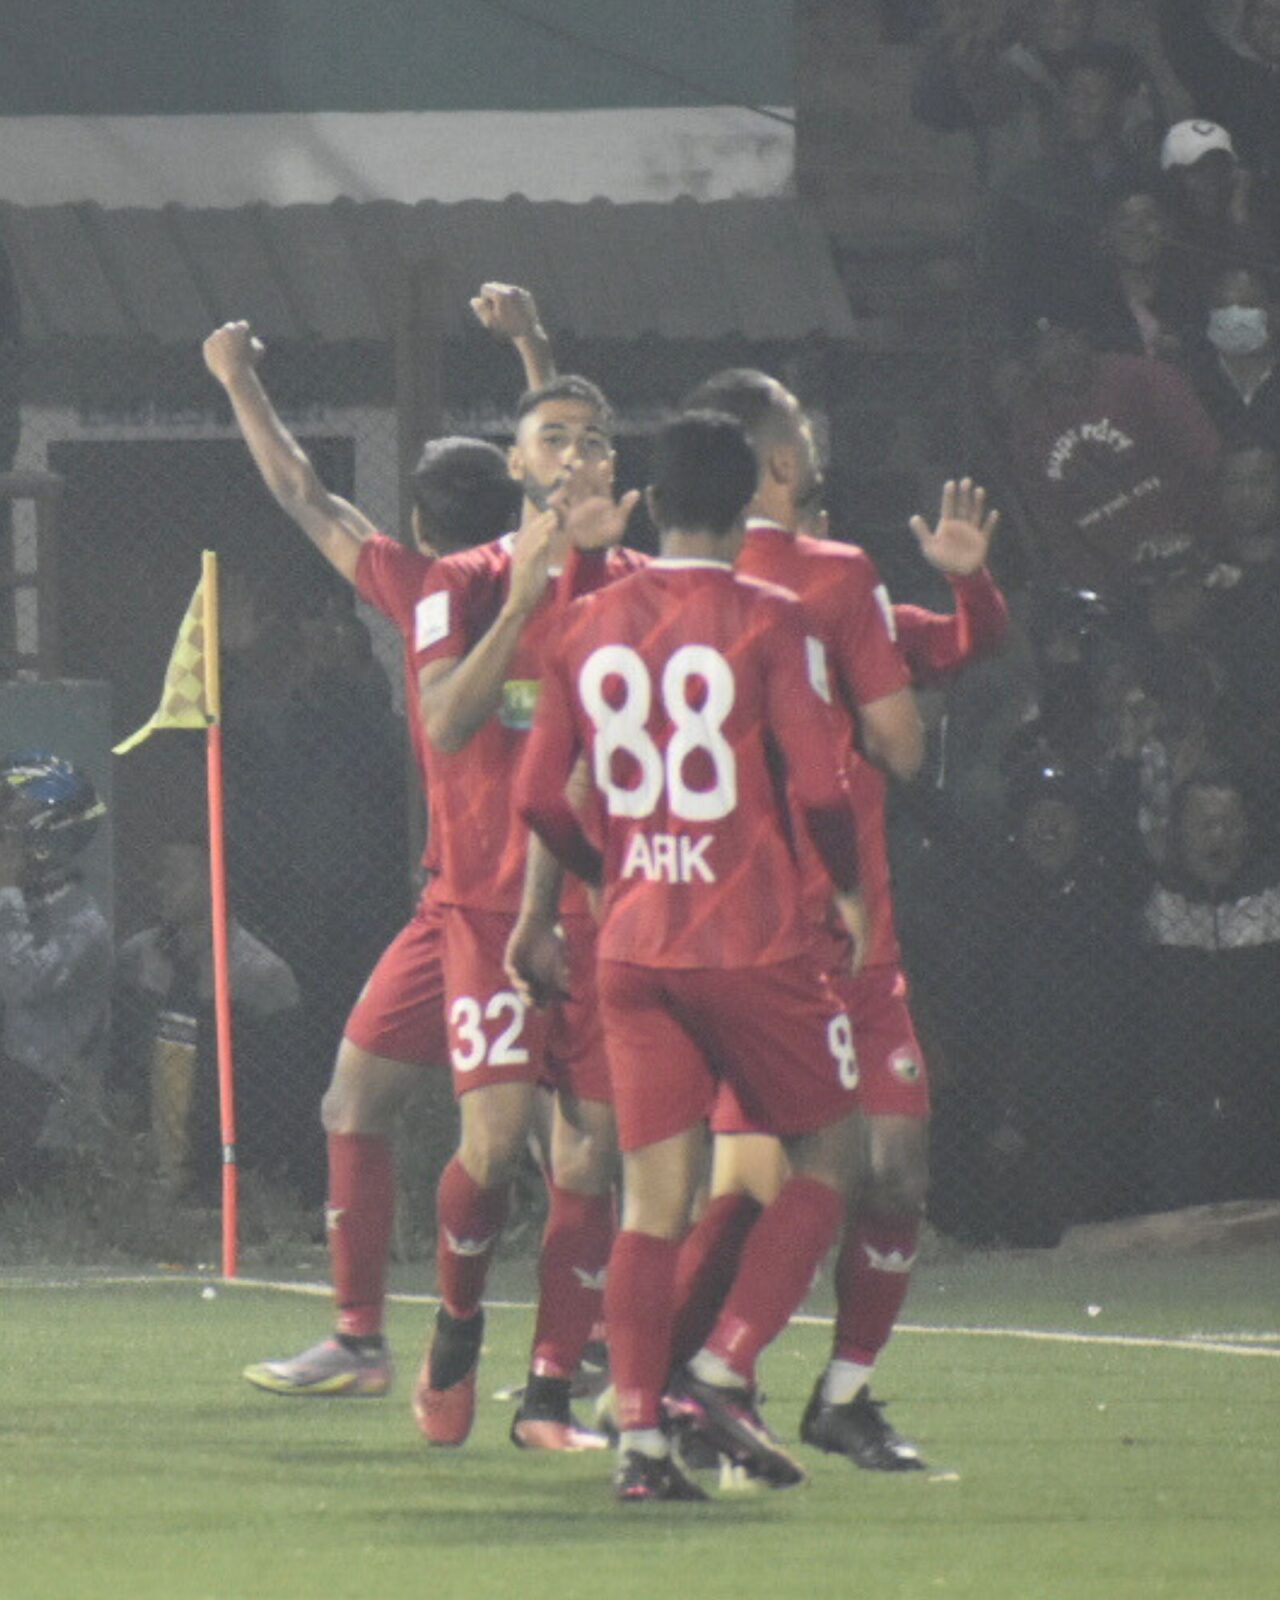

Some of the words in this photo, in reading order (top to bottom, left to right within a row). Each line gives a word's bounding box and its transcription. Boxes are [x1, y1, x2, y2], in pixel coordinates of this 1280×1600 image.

[579, 644, 738, 821] 88
[623, 833, 716, 883] ARK
[450, 992, 530, 1072] 32
